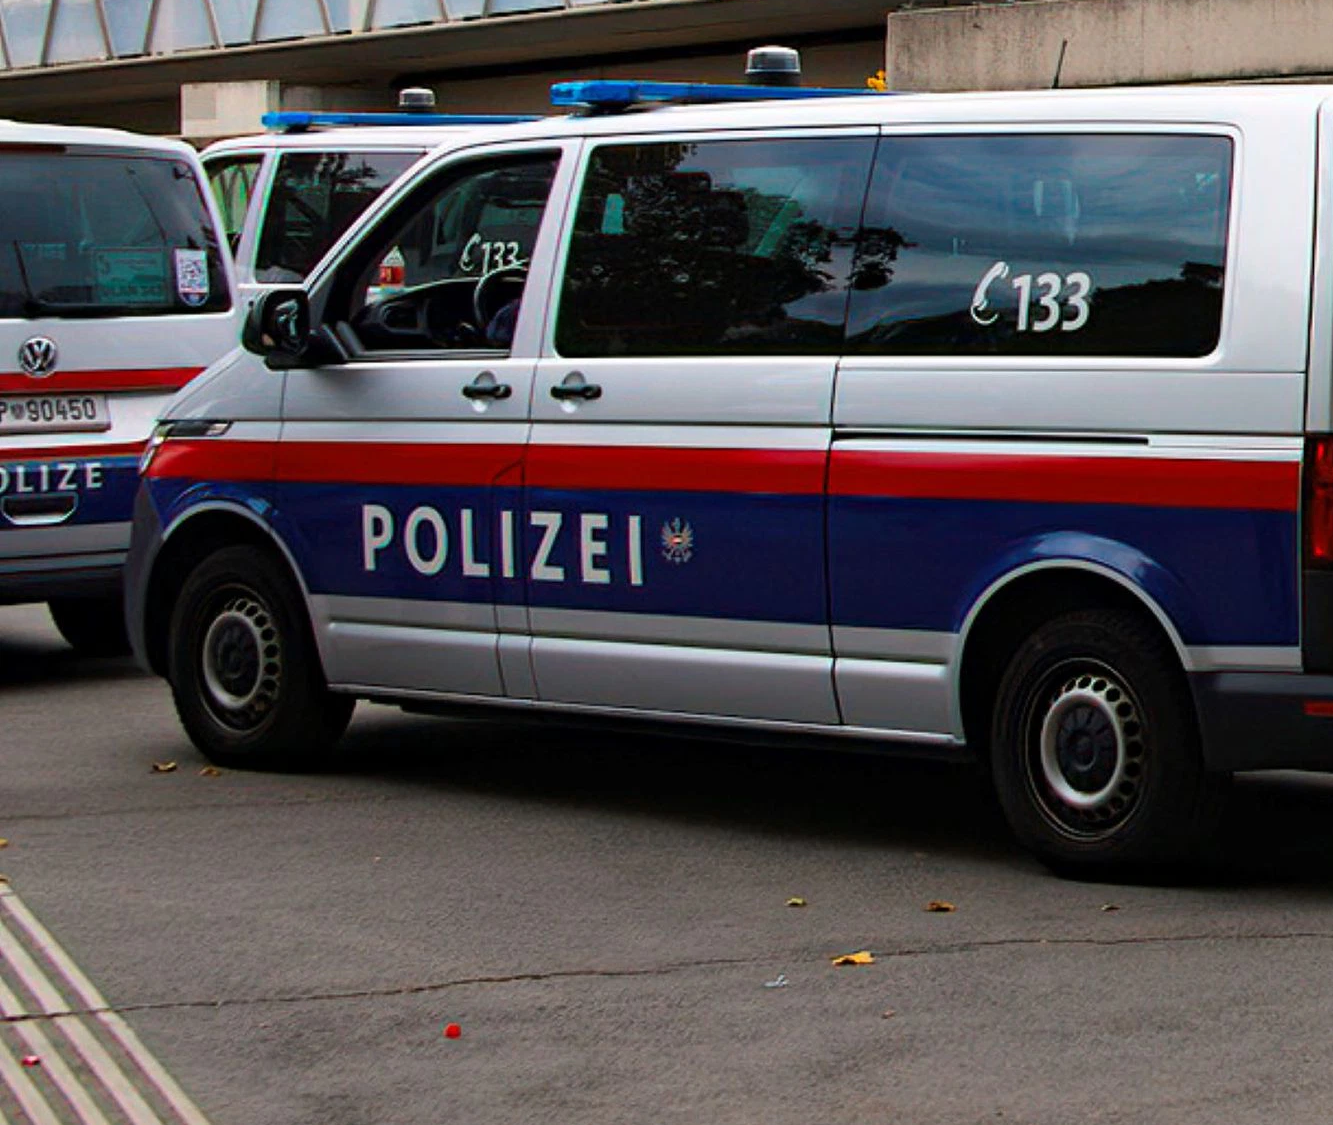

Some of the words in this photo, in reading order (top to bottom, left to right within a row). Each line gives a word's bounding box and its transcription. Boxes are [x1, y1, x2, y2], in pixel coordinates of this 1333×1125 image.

[1012, 272, 1091, 331] 133
[26, 397, 96, 422] 90450
[362, 504, 643, 586] POLIZEI
